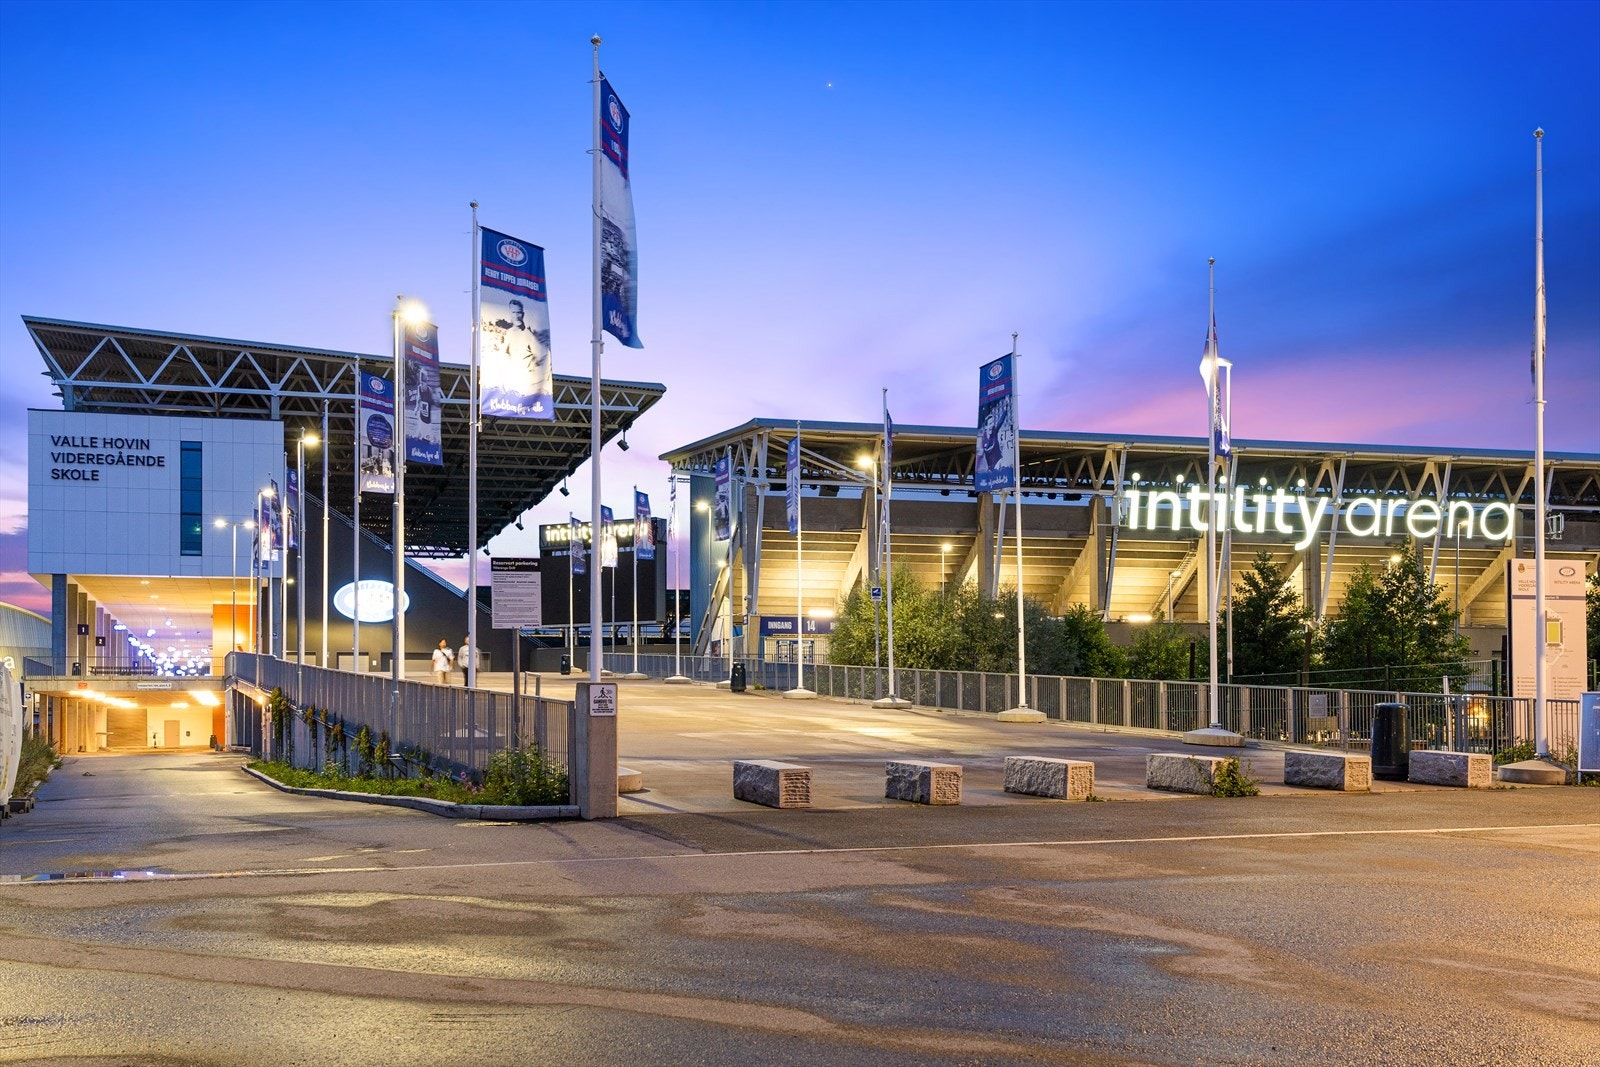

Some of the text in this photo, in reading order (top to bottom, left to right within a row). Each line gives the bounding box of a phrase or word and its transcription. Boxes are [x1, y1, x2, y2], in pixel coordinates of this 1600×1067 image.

[51, 435, 150, 450] VALLE HOVIN
[51, 451, 165, 467] VIDEREGÅENDE
[51, 468, 100, 481] SKOLE
[1125, 472, 1516, 551] intility arena
[767, 620, 816, 631] INNGANG 14
